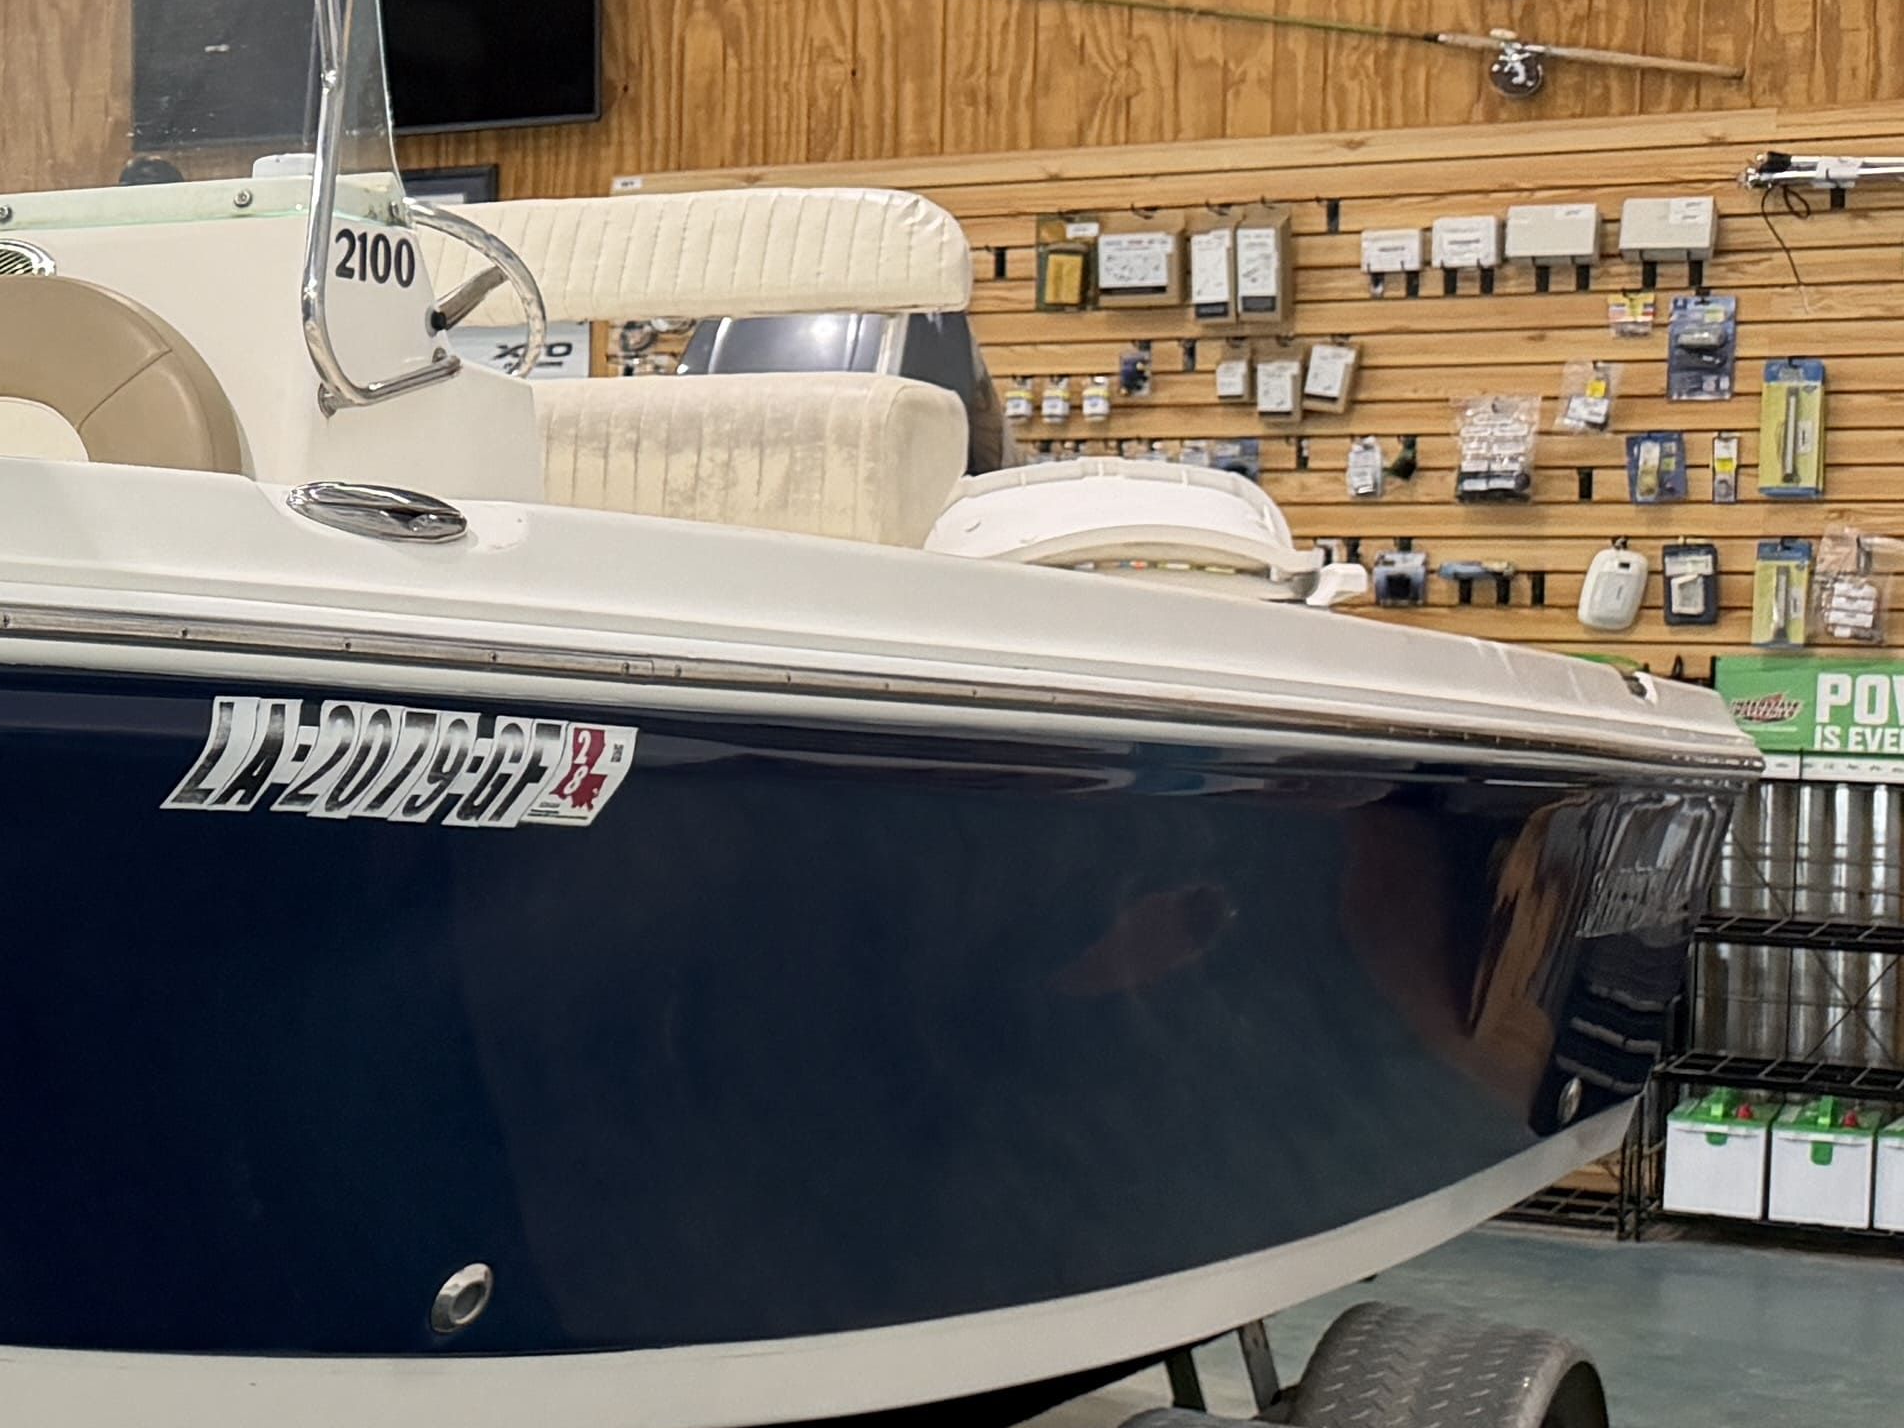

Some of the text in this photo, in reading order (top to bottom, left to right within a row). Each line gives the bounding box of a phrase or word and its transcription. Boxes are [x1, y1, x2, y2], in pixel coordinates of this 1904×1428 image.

[335, 228, 416, 289] 2100
[1814, 725, 1904, 753] IS EVE
